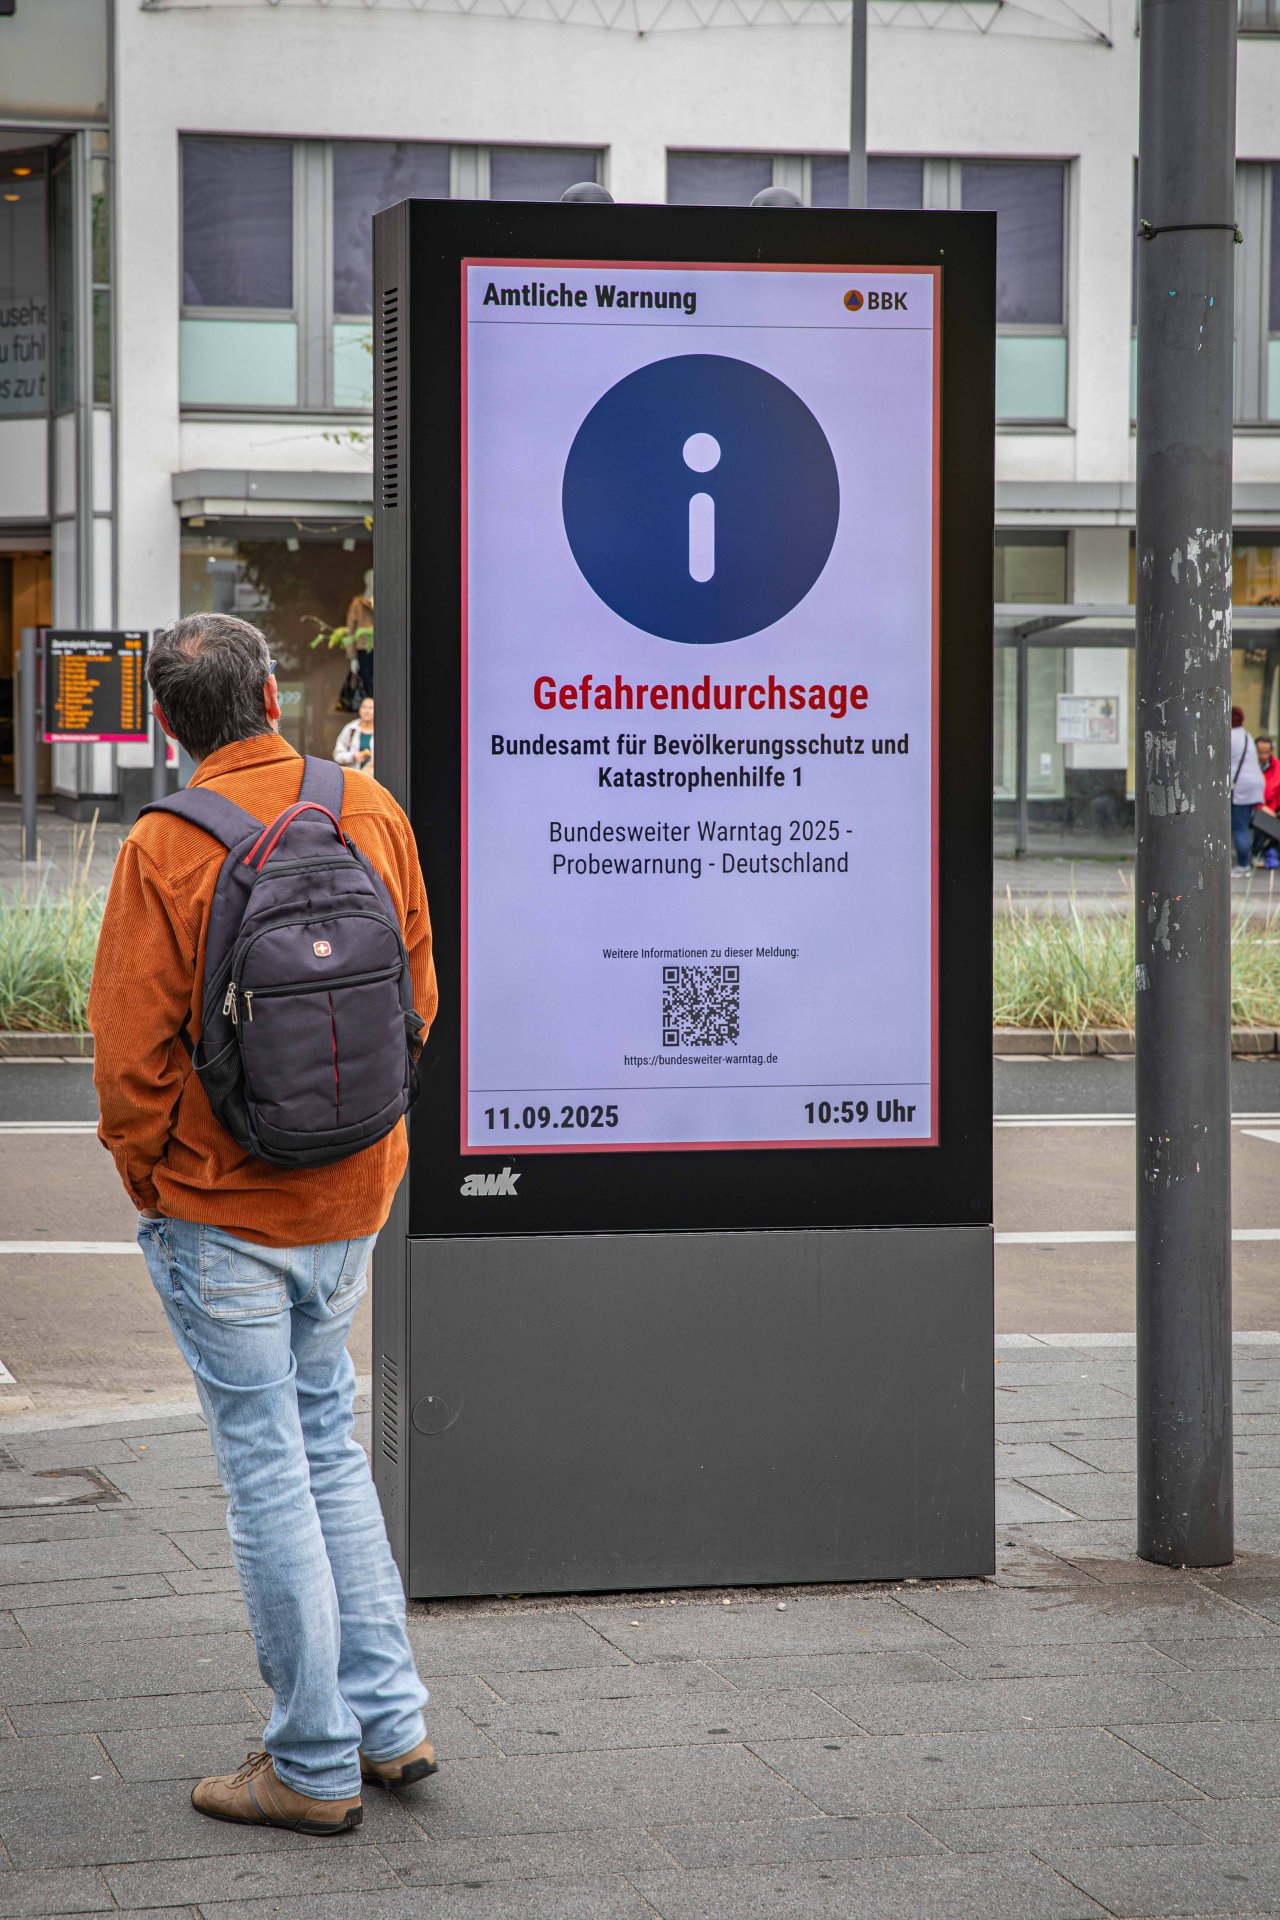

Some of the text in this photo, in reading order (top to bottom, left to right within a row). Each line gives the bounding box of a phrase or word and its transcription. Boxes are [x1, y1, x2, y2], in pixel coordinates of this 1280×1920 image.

[483, 282, 697, 315] Amtliche Warnung
[867, 291, 908, 311] BBK
[533, 675, 869, 718] Gefahrendurchsage
[491, 732, 909, 760] Bundesamt für Bevölkerungsschutz und
[598, 765, 802, 792] Katastrophenhilfe 1
[550, 821, 691, 842] Bundesweiter
[697, 821, 782, 846] Warntag
[789, 820, 840, 841] 2025
[553, 853, 702, 879] Probewarnung
[722, 852, 849, 874] Deutschland
[602, 945, 800, 960] Weitere Informationen zu dieser Meldung:
[624, 1052, 778, 1068] https://bundesweiter-warntag.de
[484, 1105, 619, 1130] 11.09.2025
[804, 1099, 917, 1124] 10:59 Uhr
[460, 1167, 522, 1196] awk
